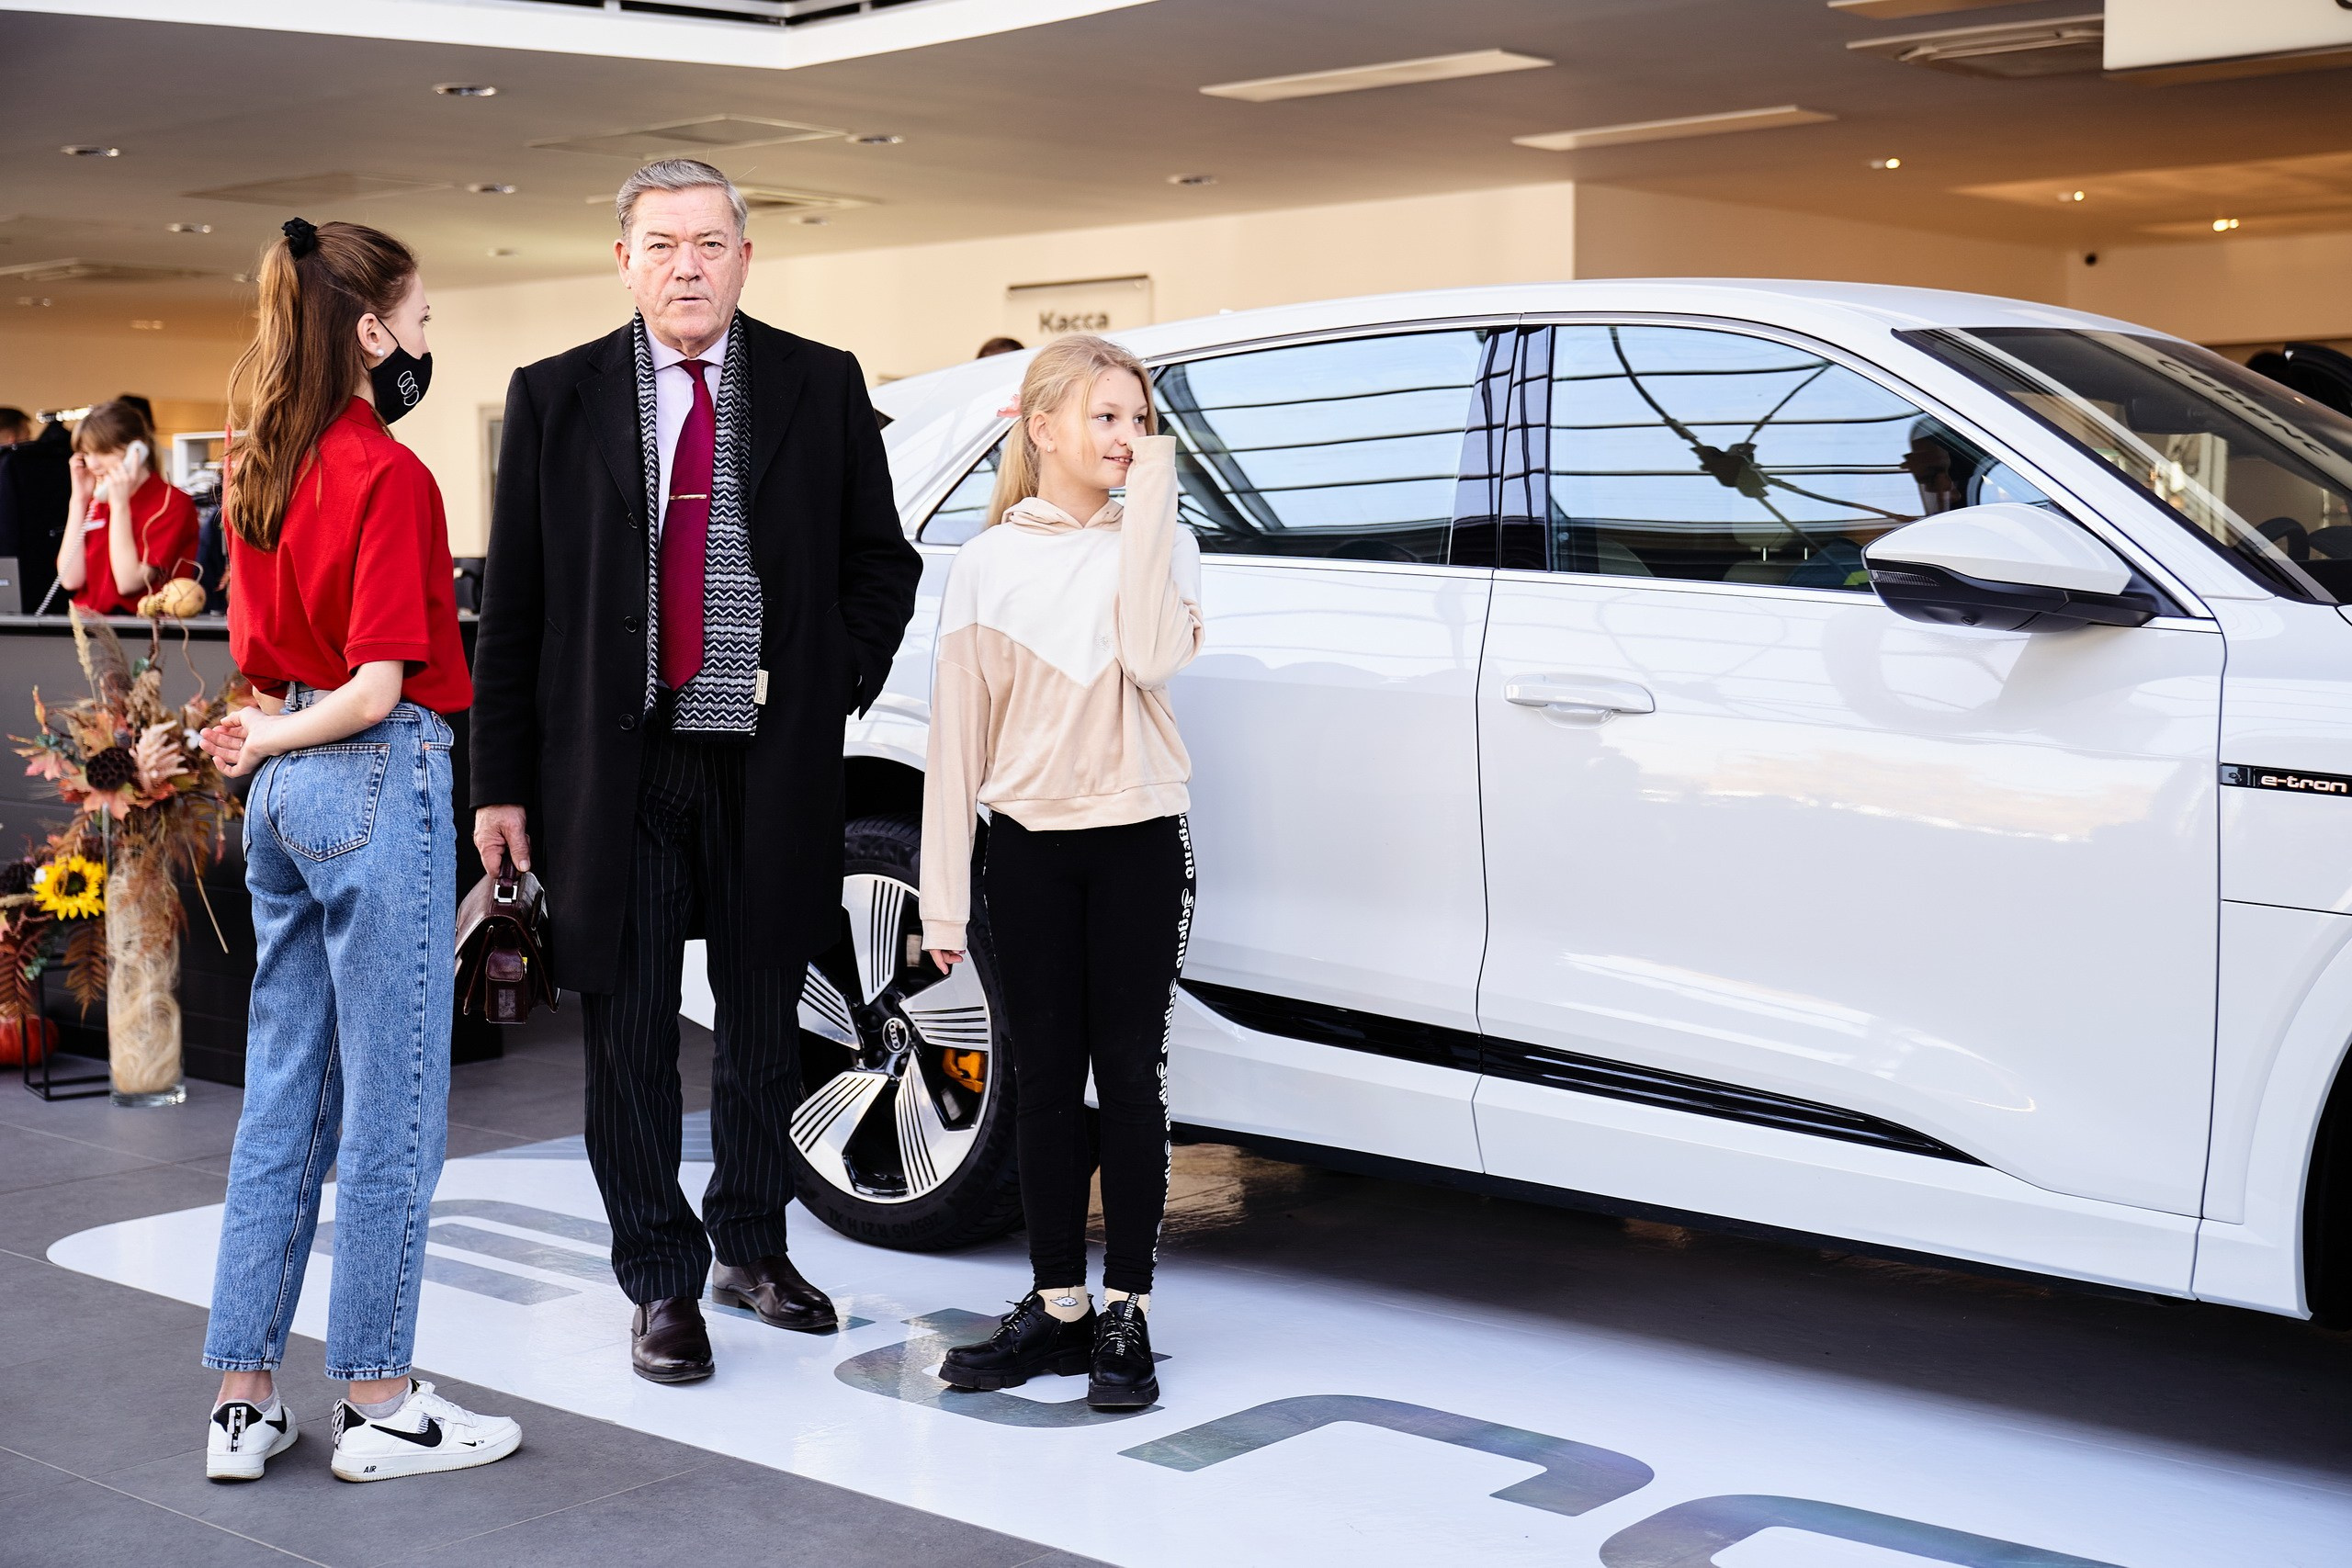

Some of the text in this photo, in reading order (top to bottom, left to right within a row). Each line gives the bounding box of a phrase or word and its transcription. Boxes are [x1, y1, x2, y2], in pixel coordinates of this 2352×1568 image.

[1039, 310, 1110, 333] Касса
[2261, 775, 2347, 793] e-tron
[363, 1465, 377, 1473] AIR
